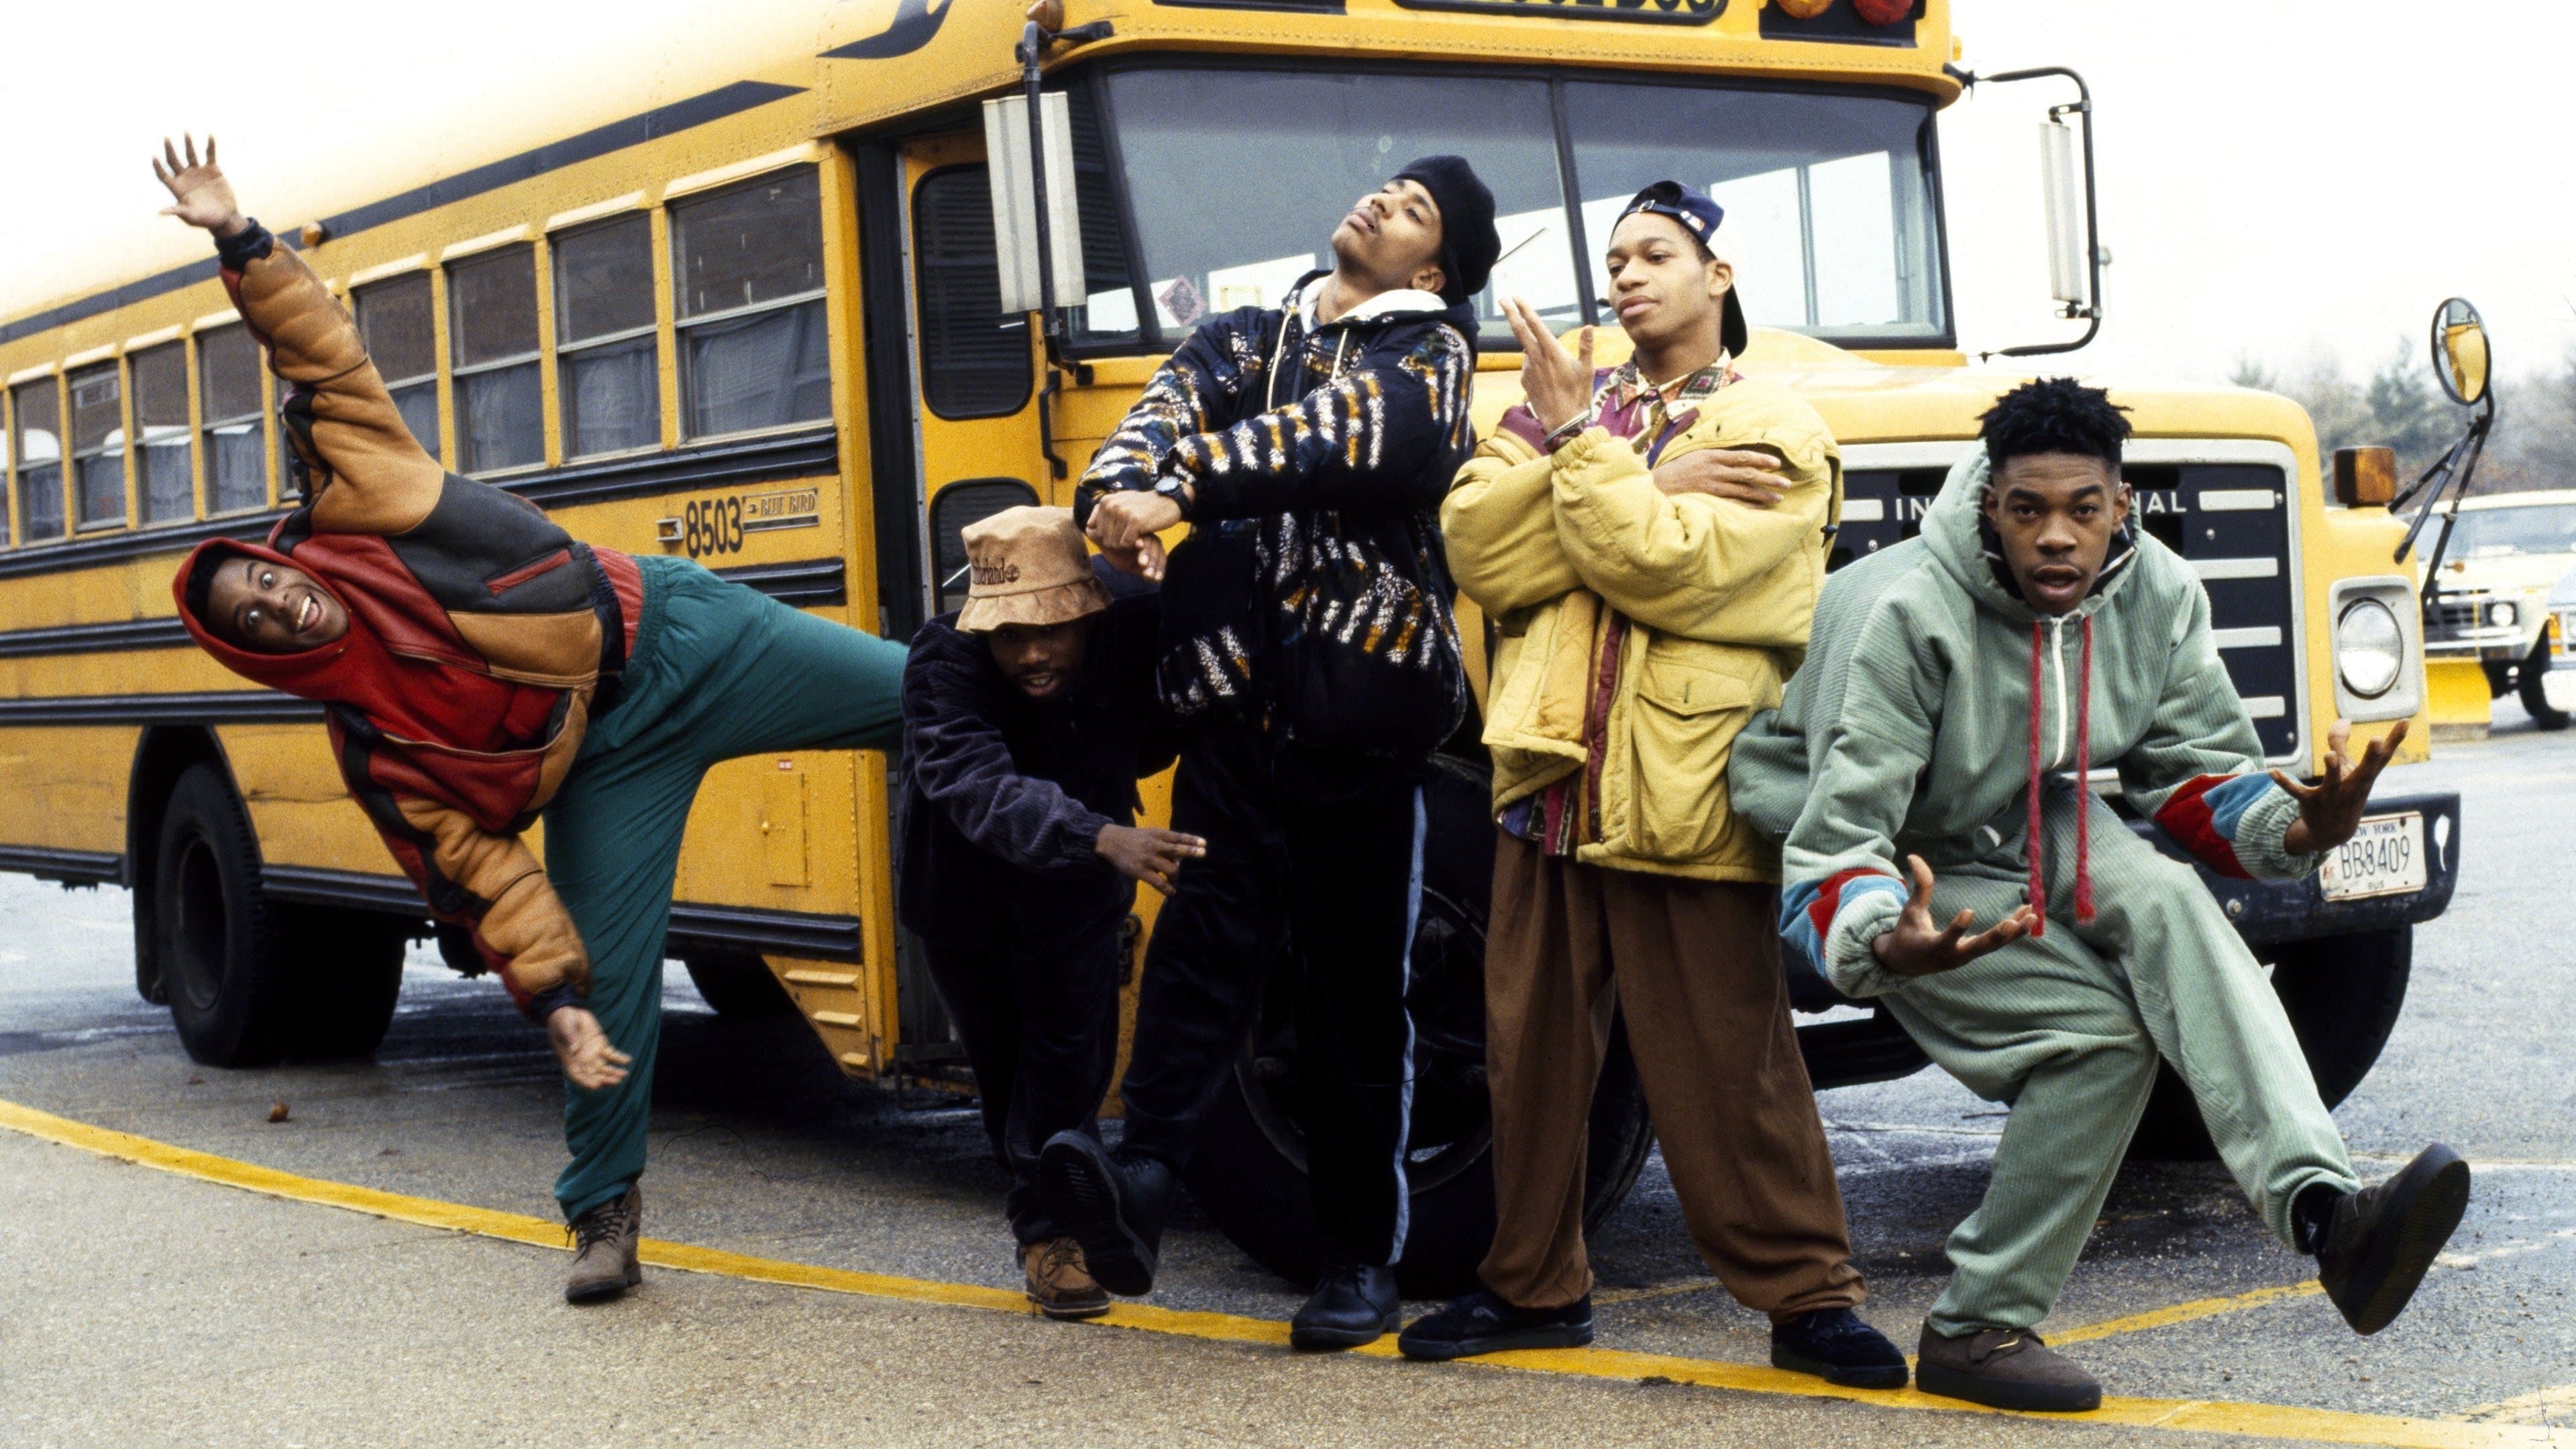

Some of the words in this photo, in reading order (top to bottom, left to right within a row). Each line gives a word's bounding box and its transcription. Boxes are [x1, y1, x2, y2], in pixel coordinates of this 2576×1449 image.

[761, 496, 784, 516] BLUE
[789, 493, 816, 514] BIRD
[686, 496, 743, 559] 8503
[2373, 822, 2397, 836] YORK
